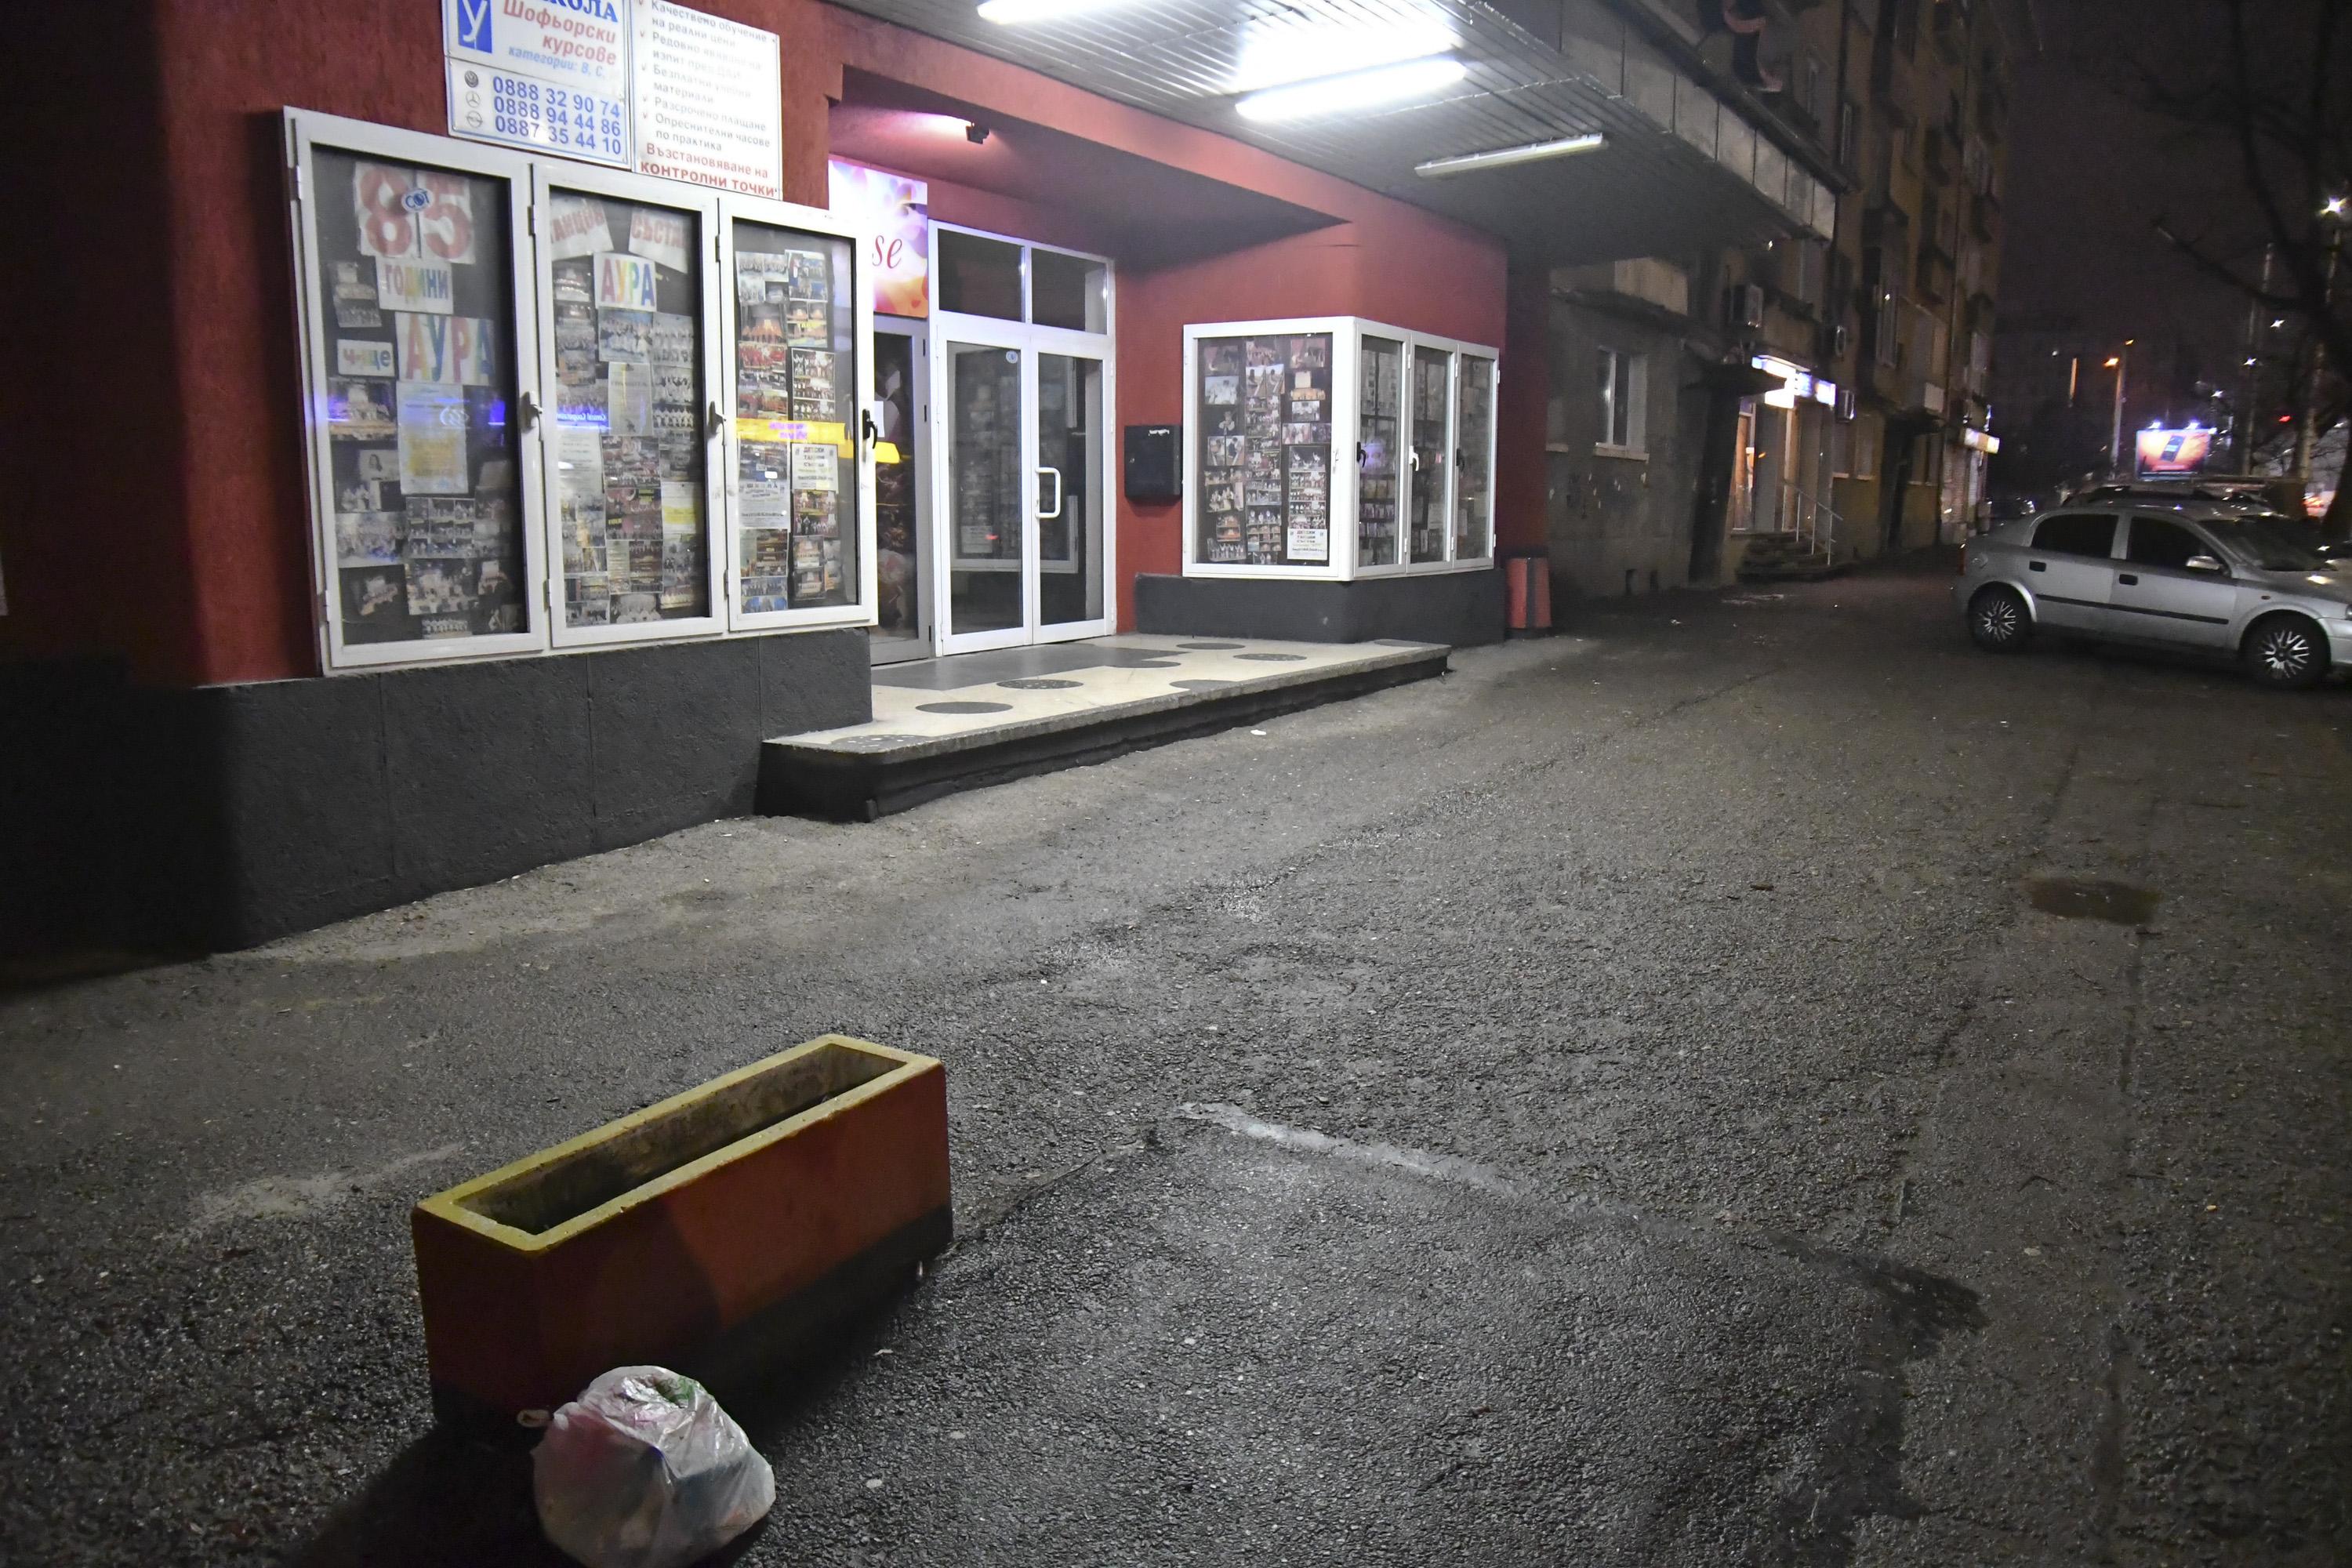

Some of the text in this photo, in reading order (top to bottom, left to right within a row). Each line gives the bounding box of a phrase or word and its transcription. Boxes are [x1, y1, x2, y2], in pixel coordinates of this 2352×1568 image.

[503, 0, 616, 44] Шофьорски
[652, 0, 767, 42] Качествено обучение
[652, 17, 735, 48] на реални цени
[509, 46, 577, 71] категории:
[542, 34, 616, 66] курсове
[652, 31, 702, 54] Редовно
[653, 49, 684, 65] изпит
[653, 64, 712, 88] Безплатни
[654, 82, 713, 103] материали
[493, 76, 620, 118] 0888 32 90 74
[655, 96, 766, 132] Разсрочено плащане
[494, 96, 621, 136] 0888 94 44 86
[655, 113, 771, 147] Опреснителни часове
[495, 115, 621, 154] 0887 35 44 10
[656, 130, 722, 151] по практика
[646, 143, 768, 179] Възстановяване на
[641, 162, 775, 197] КОНТРОЛНИ ТОЧКИ
[361, 169, 471, 259] 85
[550, 201, 605, 244] АНЦОВ
[385, 264, 449, 304] ГОДИНИ
[601, 258, 655, 307] АУРА
[405, 314, 495, 384] АУРА
